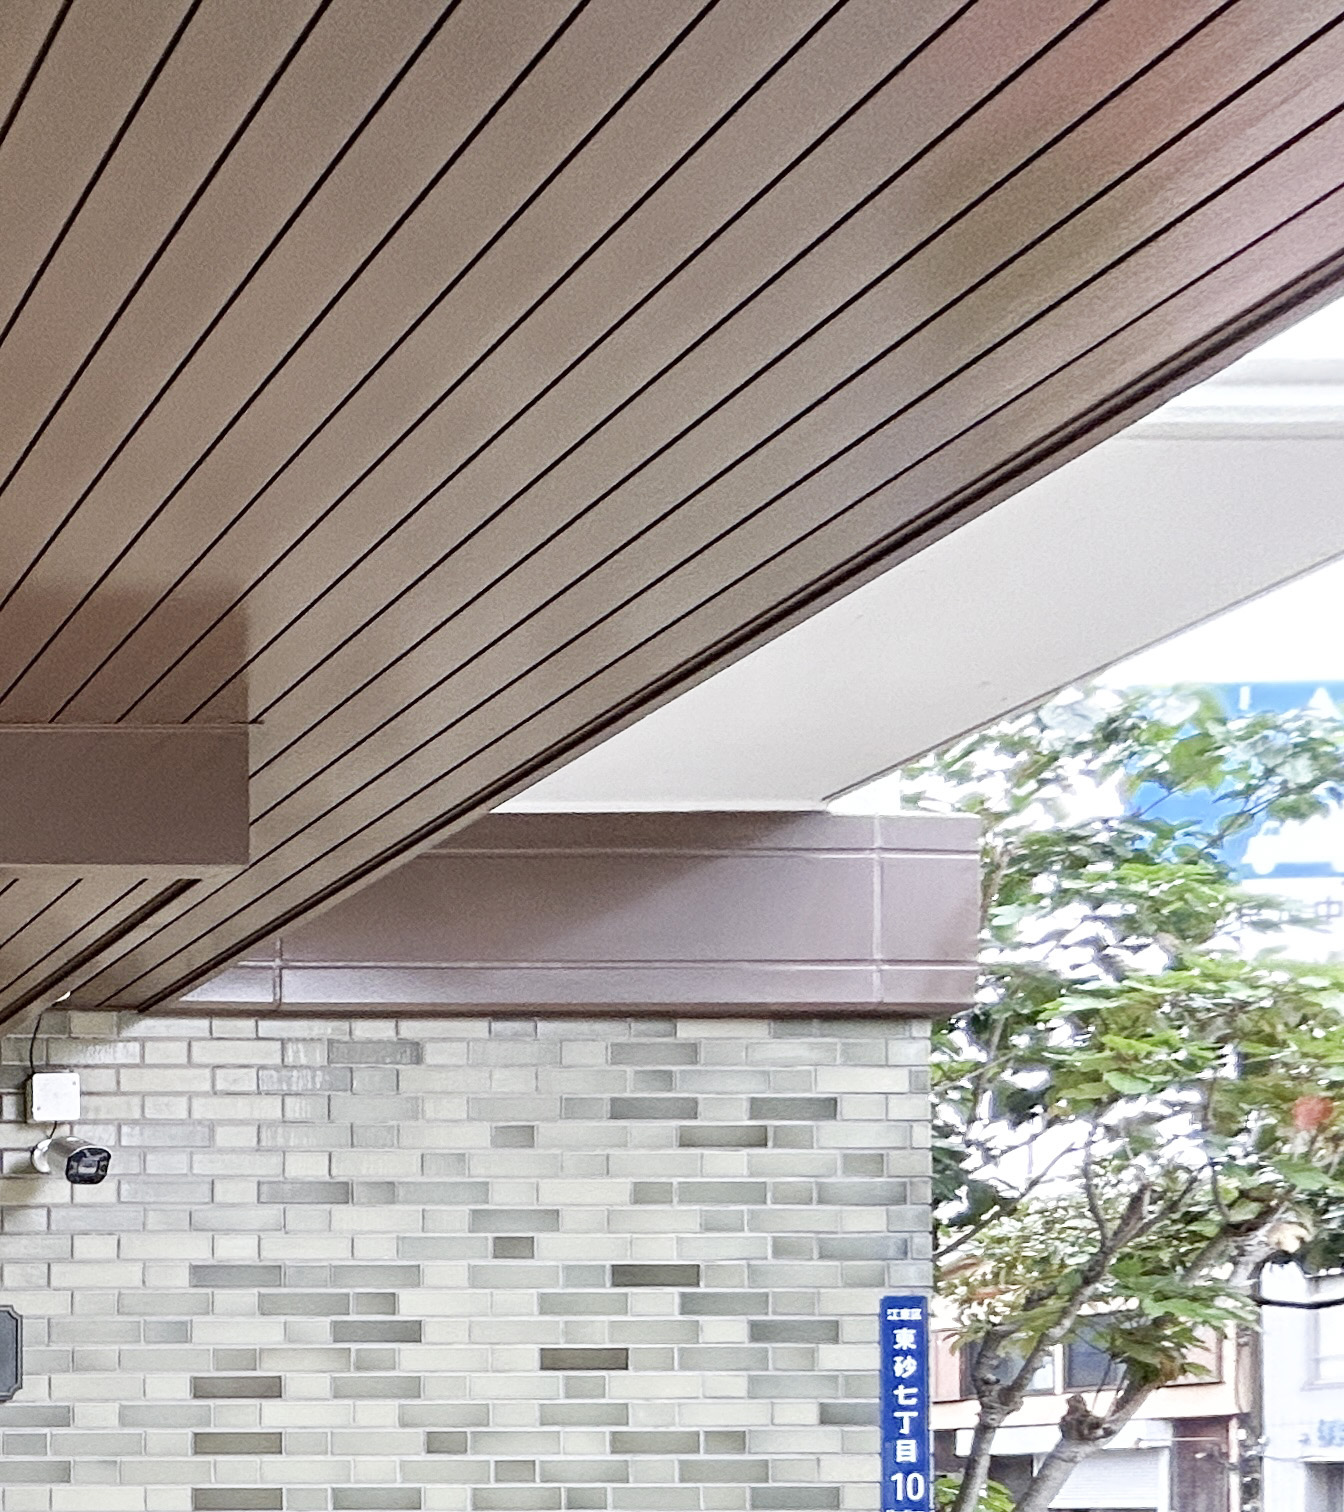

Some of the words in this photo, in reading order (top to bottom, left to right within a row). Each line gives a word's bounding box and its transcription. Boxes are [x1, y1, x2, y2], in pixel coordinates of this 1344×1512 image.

[892, 1327, 919, 1463] 東砂七丁目
[890, 1472, 925, 1501] 10
